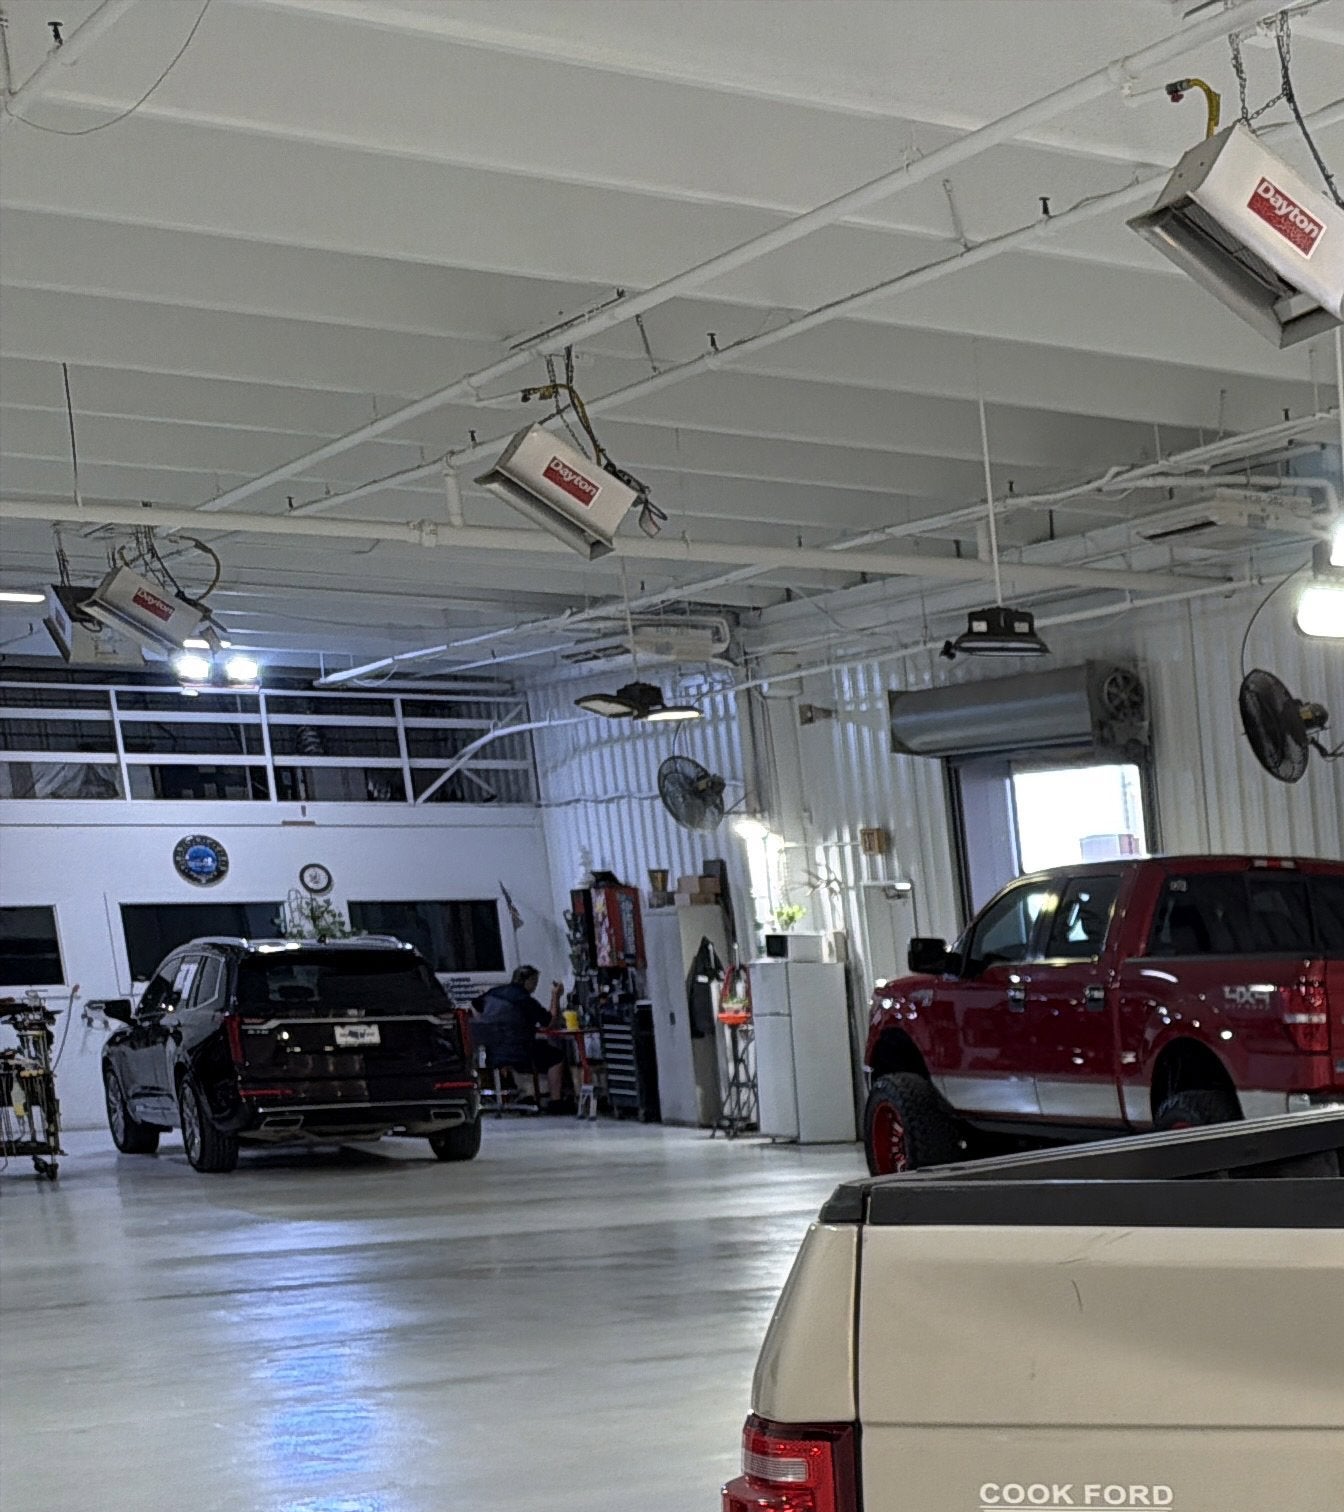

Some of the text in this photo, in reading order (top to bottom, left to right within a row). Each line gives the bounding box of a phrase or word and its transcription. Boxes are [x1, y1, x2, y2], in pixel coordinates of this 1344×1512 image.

[1256, 181, 1320, 238] Dayton
[550, 459, 597, 496] Dayton
[979, 1483, 1174, 1505] COOK FORD
